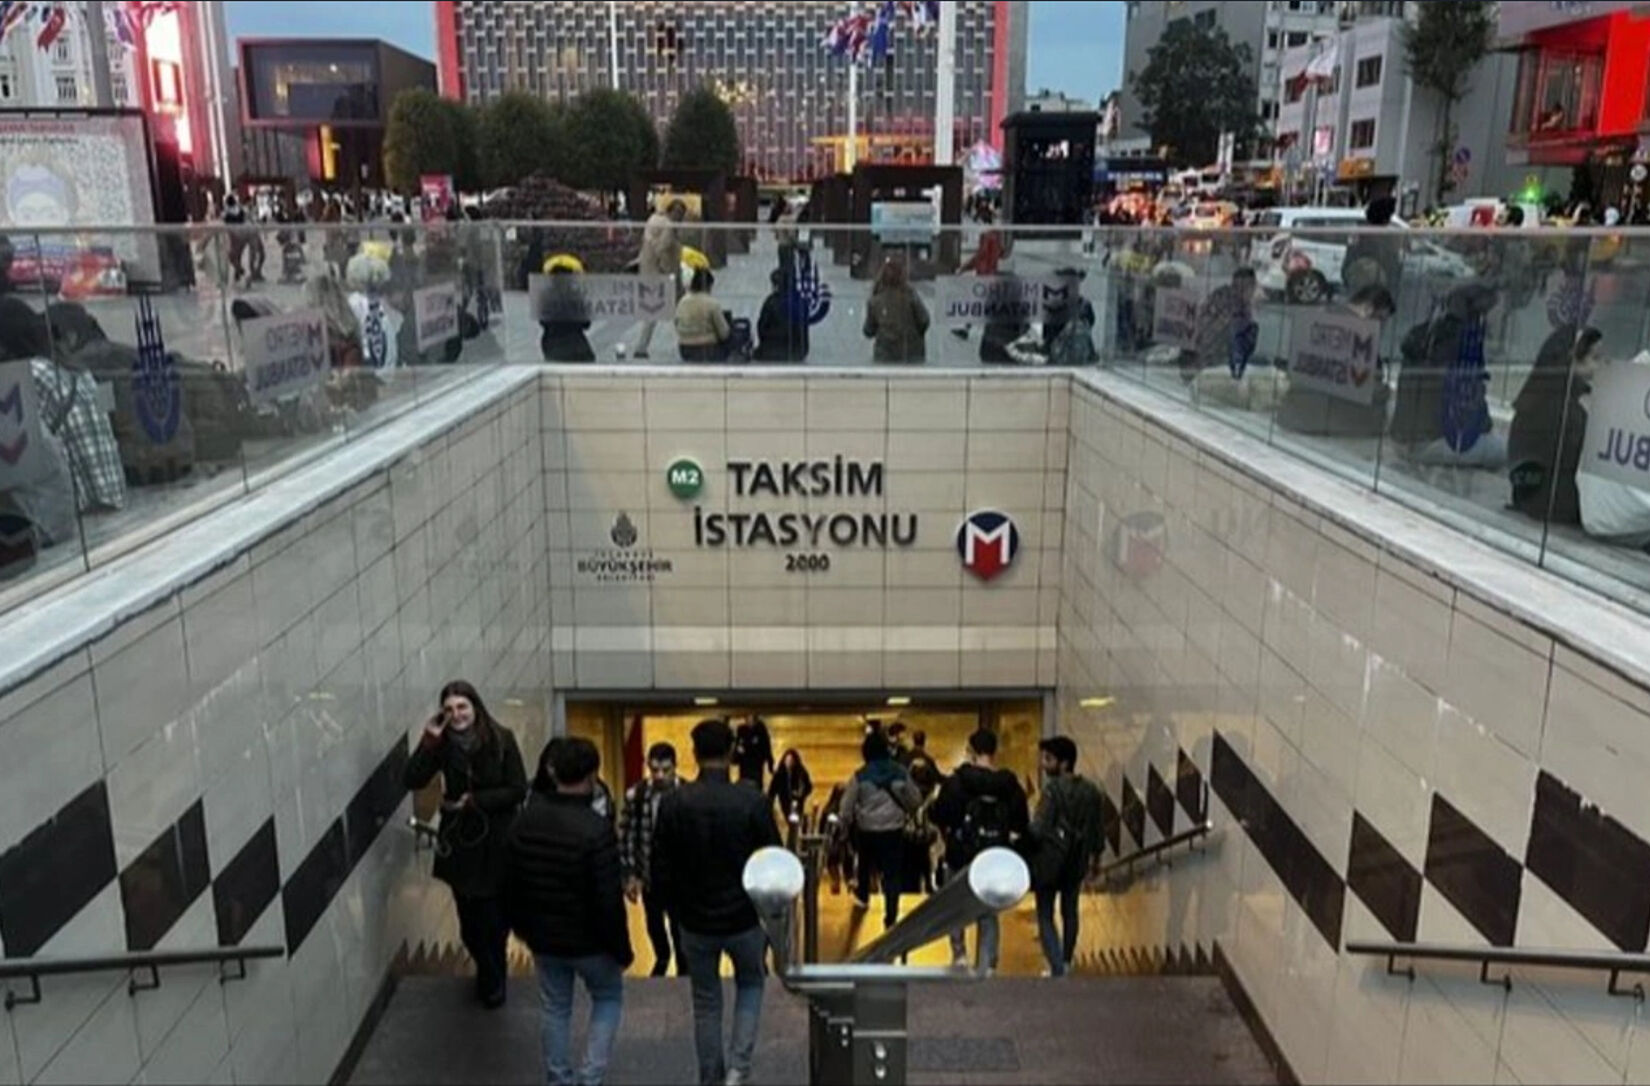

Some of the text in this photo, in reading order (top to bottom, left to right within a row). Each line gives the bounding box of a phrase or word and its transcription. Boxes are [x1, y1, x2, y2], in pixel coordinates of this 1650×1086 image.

[671, 470, 700, 485] M2
[727, 454, 884, 497] TAKSİM
[694, 505, 917, 547] İSTASYONU
[785, 553, 830, 573] 2000
